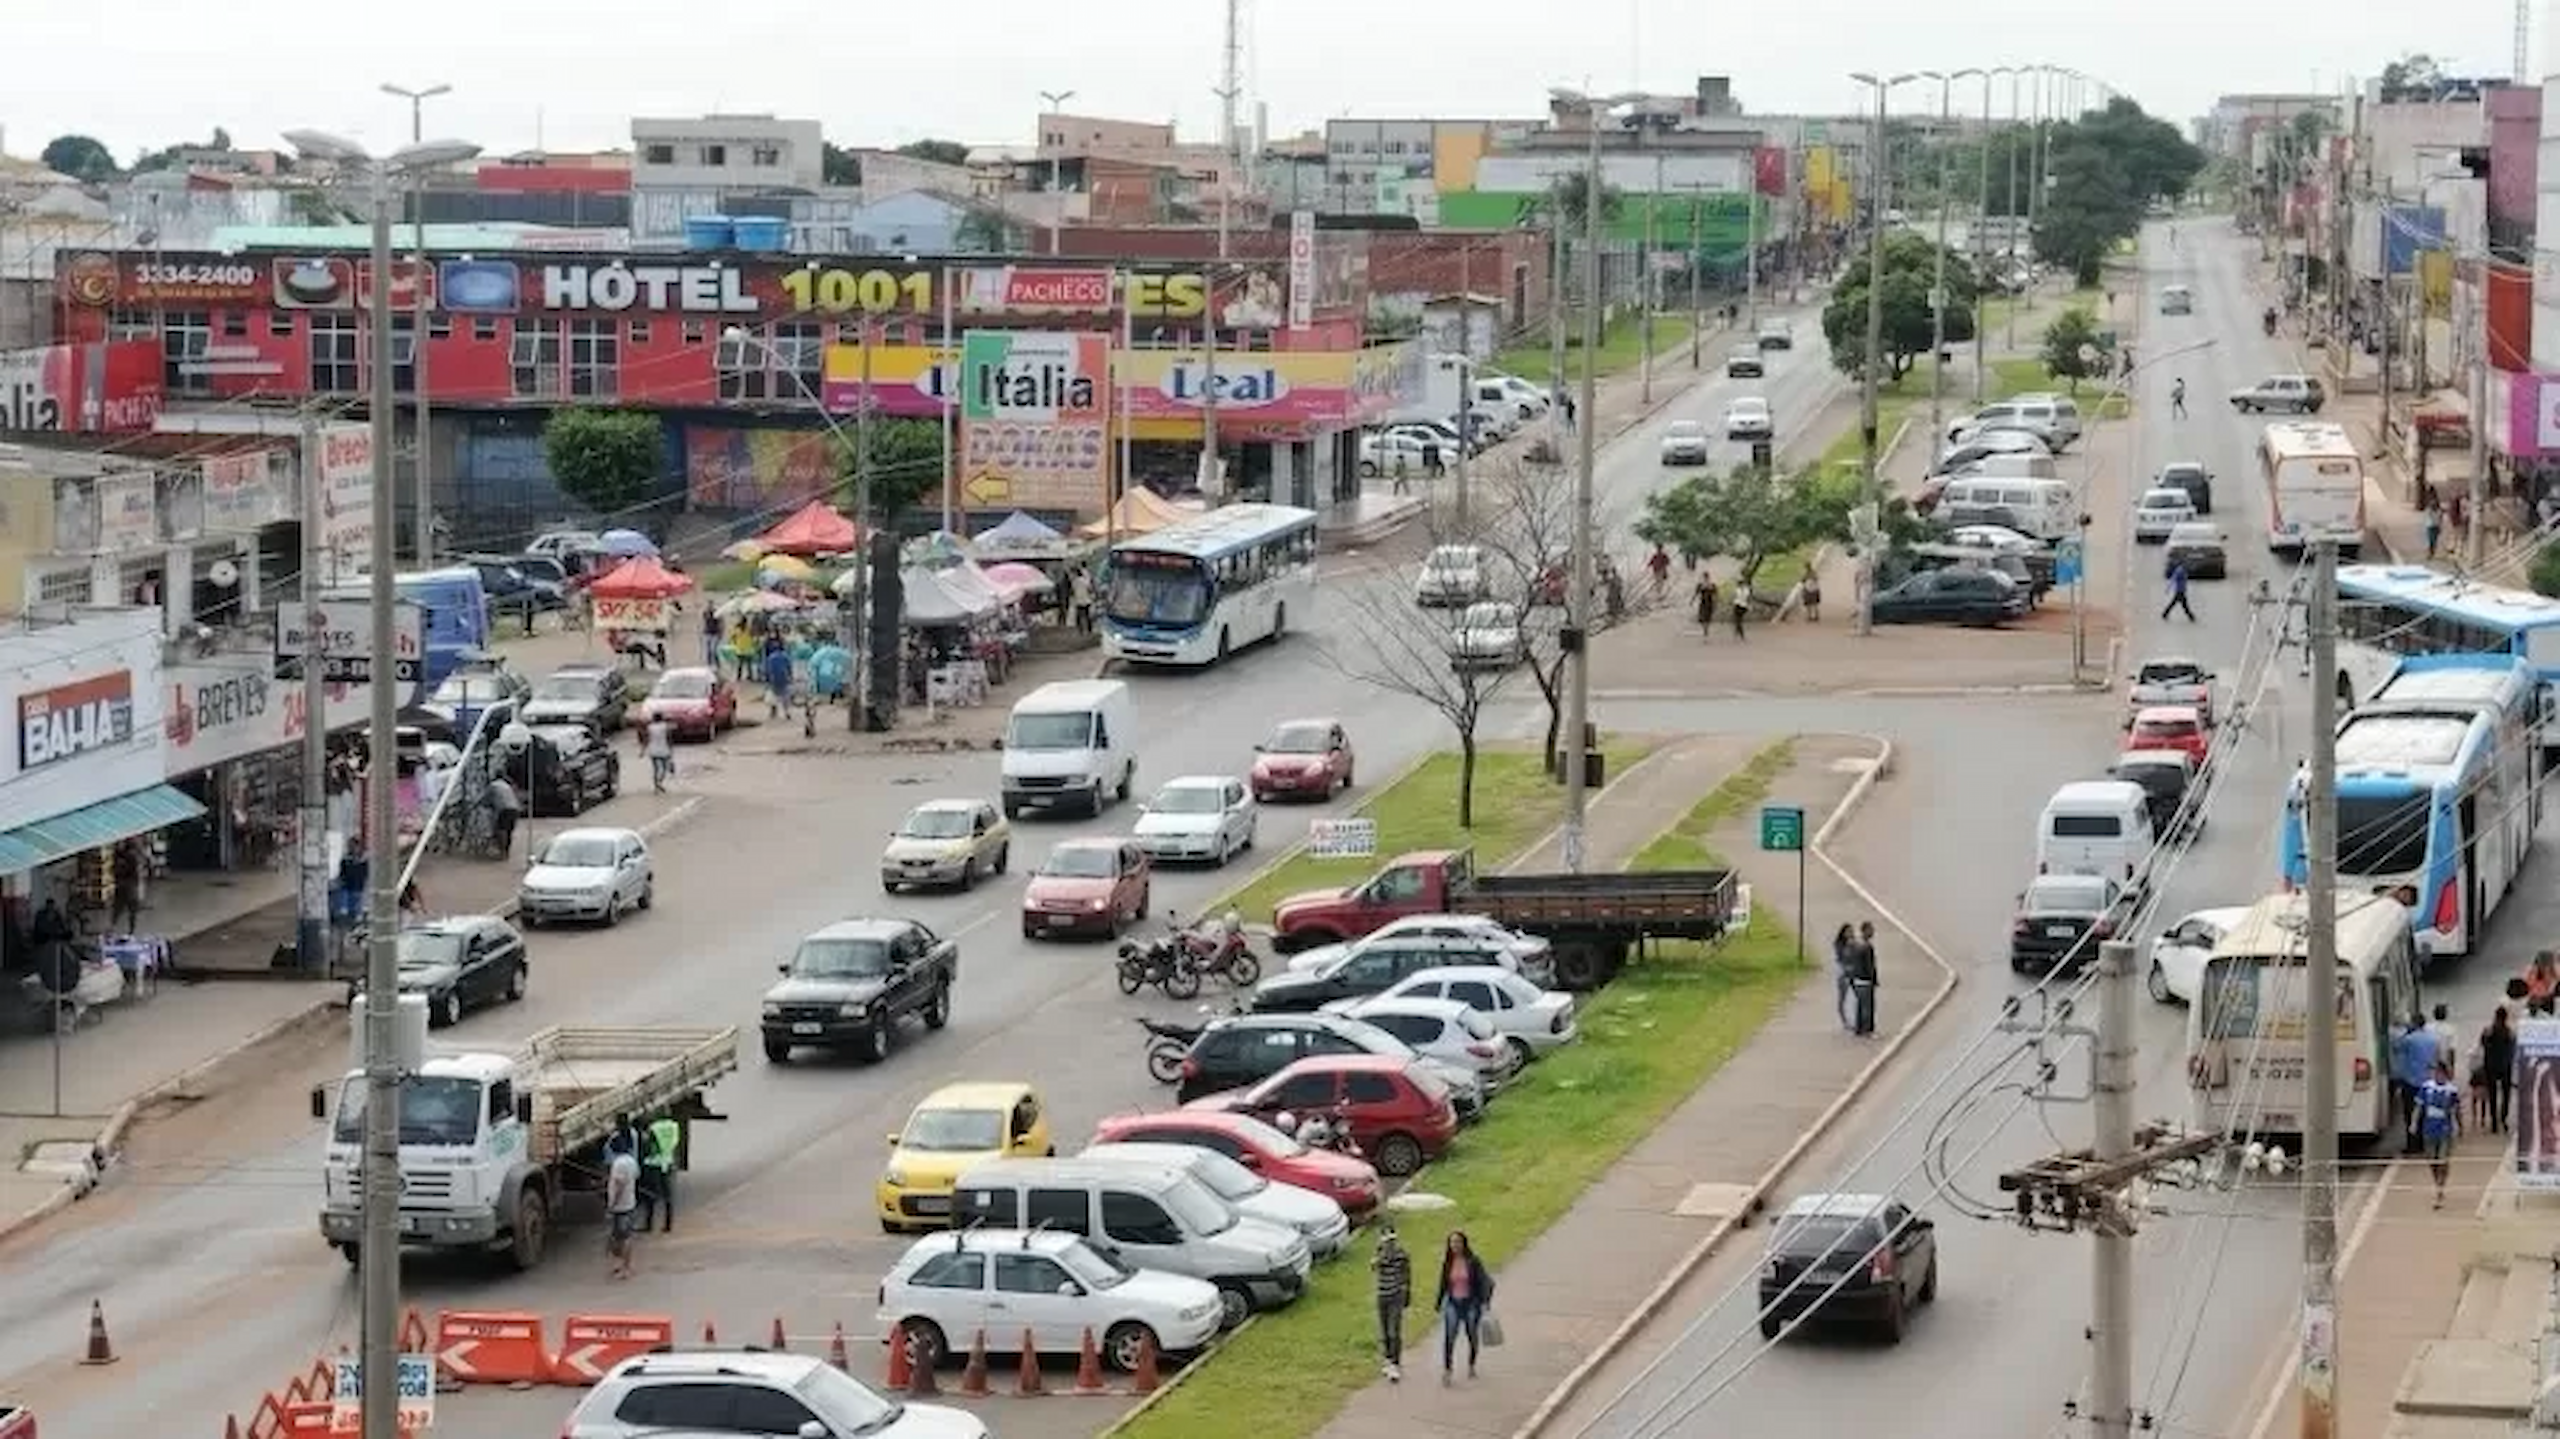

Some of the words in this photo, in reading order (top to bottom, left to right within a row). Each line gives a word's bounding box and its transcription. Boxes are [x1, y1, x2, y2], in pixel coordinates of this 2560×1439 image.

[135, 263, 254, 286] 3334-2400
[781, 268, 933, 315] 1001
[1011, 282, 1105, 300] PACHECO
[978, 363, 1094, 409] Itália
[1173, 367, 1275, 400] Leal
[25, 699, 114, 766] BAHIA
